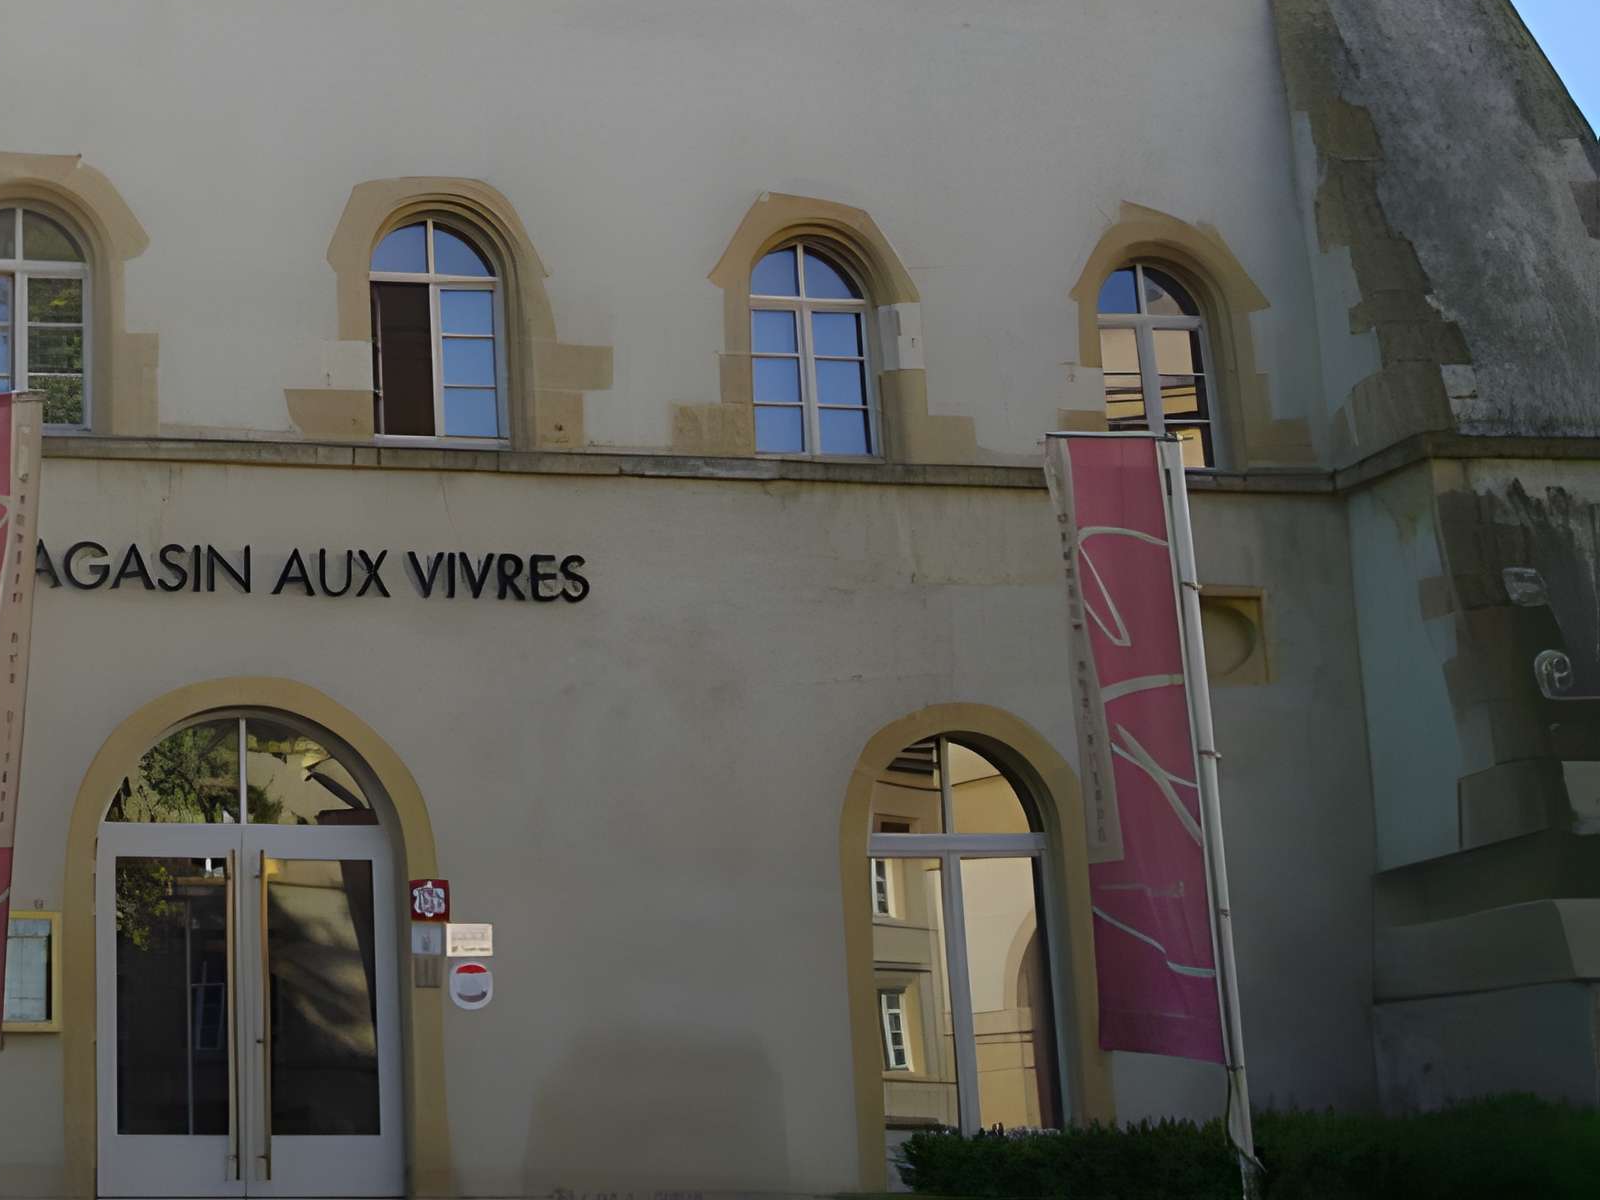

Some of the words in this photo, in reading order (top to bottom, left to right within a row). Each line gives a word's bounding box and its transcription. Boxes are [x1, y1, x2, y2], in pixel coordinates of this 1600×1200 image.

[35, 538, 251, 593] AGASIN
[271, 548, 391, 598] AUX
[407, 551, 590, 602] VIVRES
